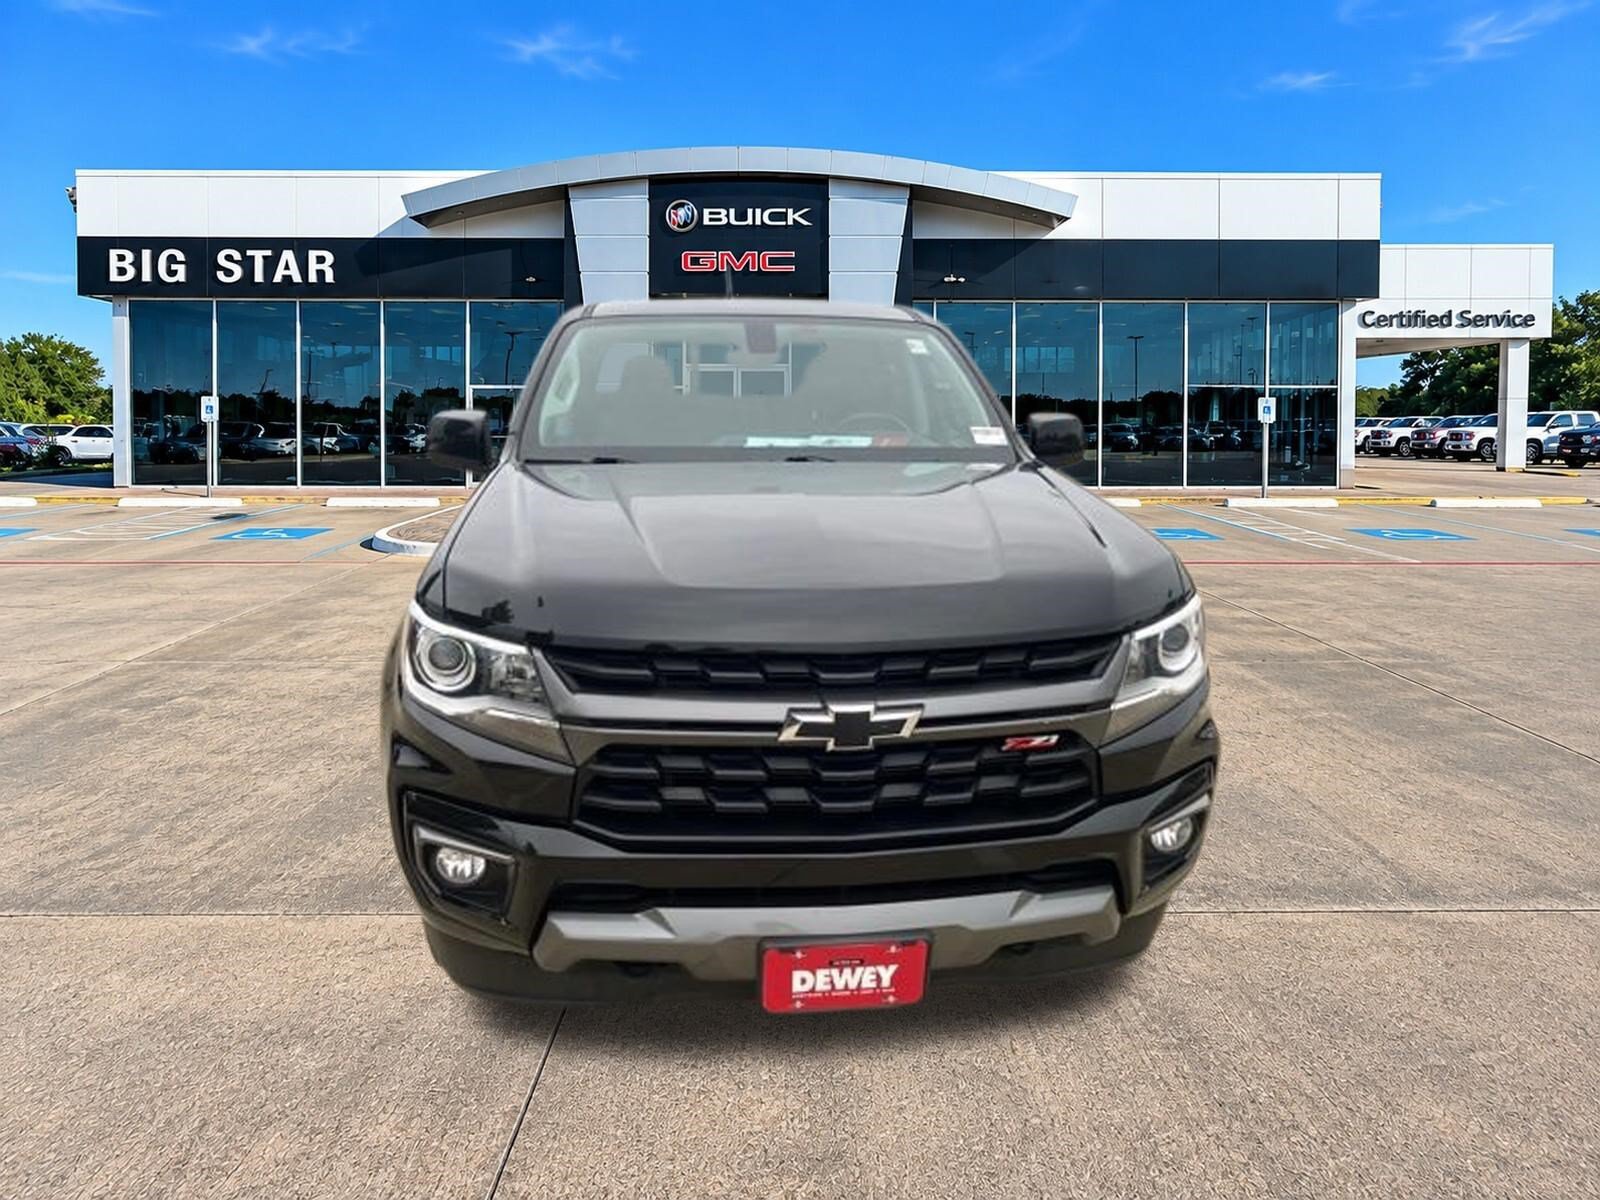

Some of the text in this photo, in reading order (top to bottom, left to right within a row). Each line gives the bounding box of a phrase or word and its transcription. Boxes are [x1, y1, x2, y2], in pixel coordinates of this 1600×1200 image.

[702, 208, 813, 226] BUICK
[108, 248, 335, 284] BIG STAR
[681, 250, 796, 272] GMC
[1359, 309, 1536, 328] Certified Service
[791, 964, 899, 993] DEWEY
